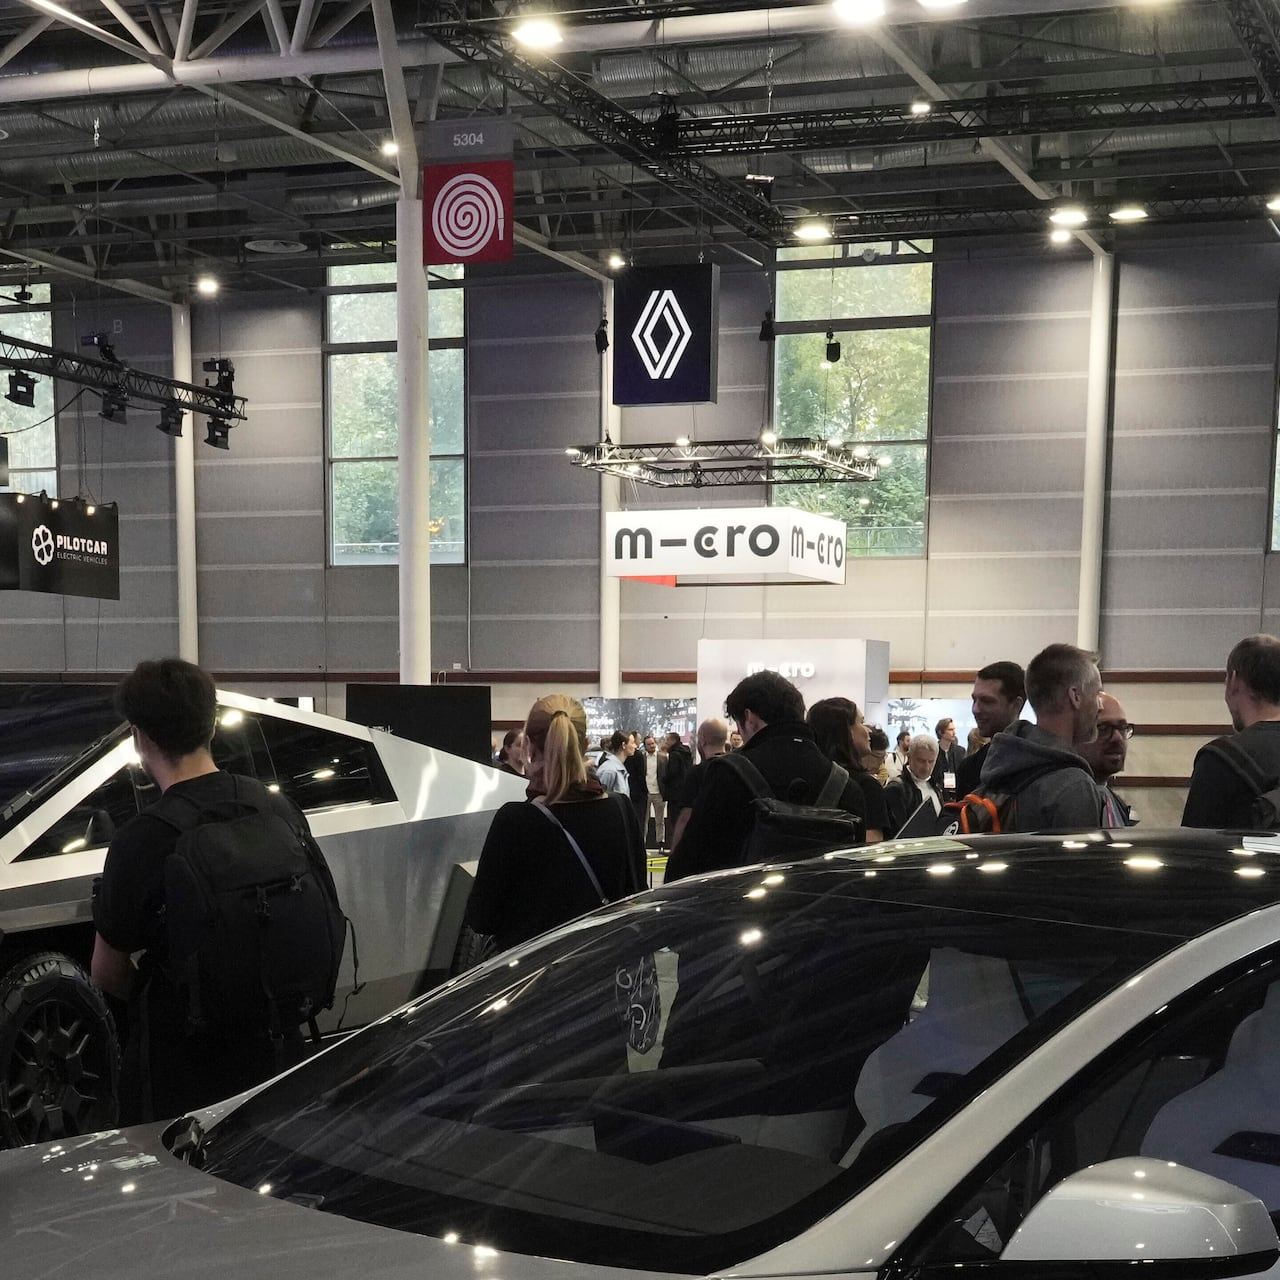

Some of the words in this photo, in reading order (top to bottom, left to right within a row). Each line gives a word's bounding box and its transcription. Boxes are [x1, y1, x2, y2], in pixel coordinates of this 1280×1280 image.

[453, 132, 485, 146] 5304
[56, 534, 108, 555] PILOTCAR
[57, 551, 82, 561] ELECTRIC
[83, 556, 108, 565] VEHICLES
